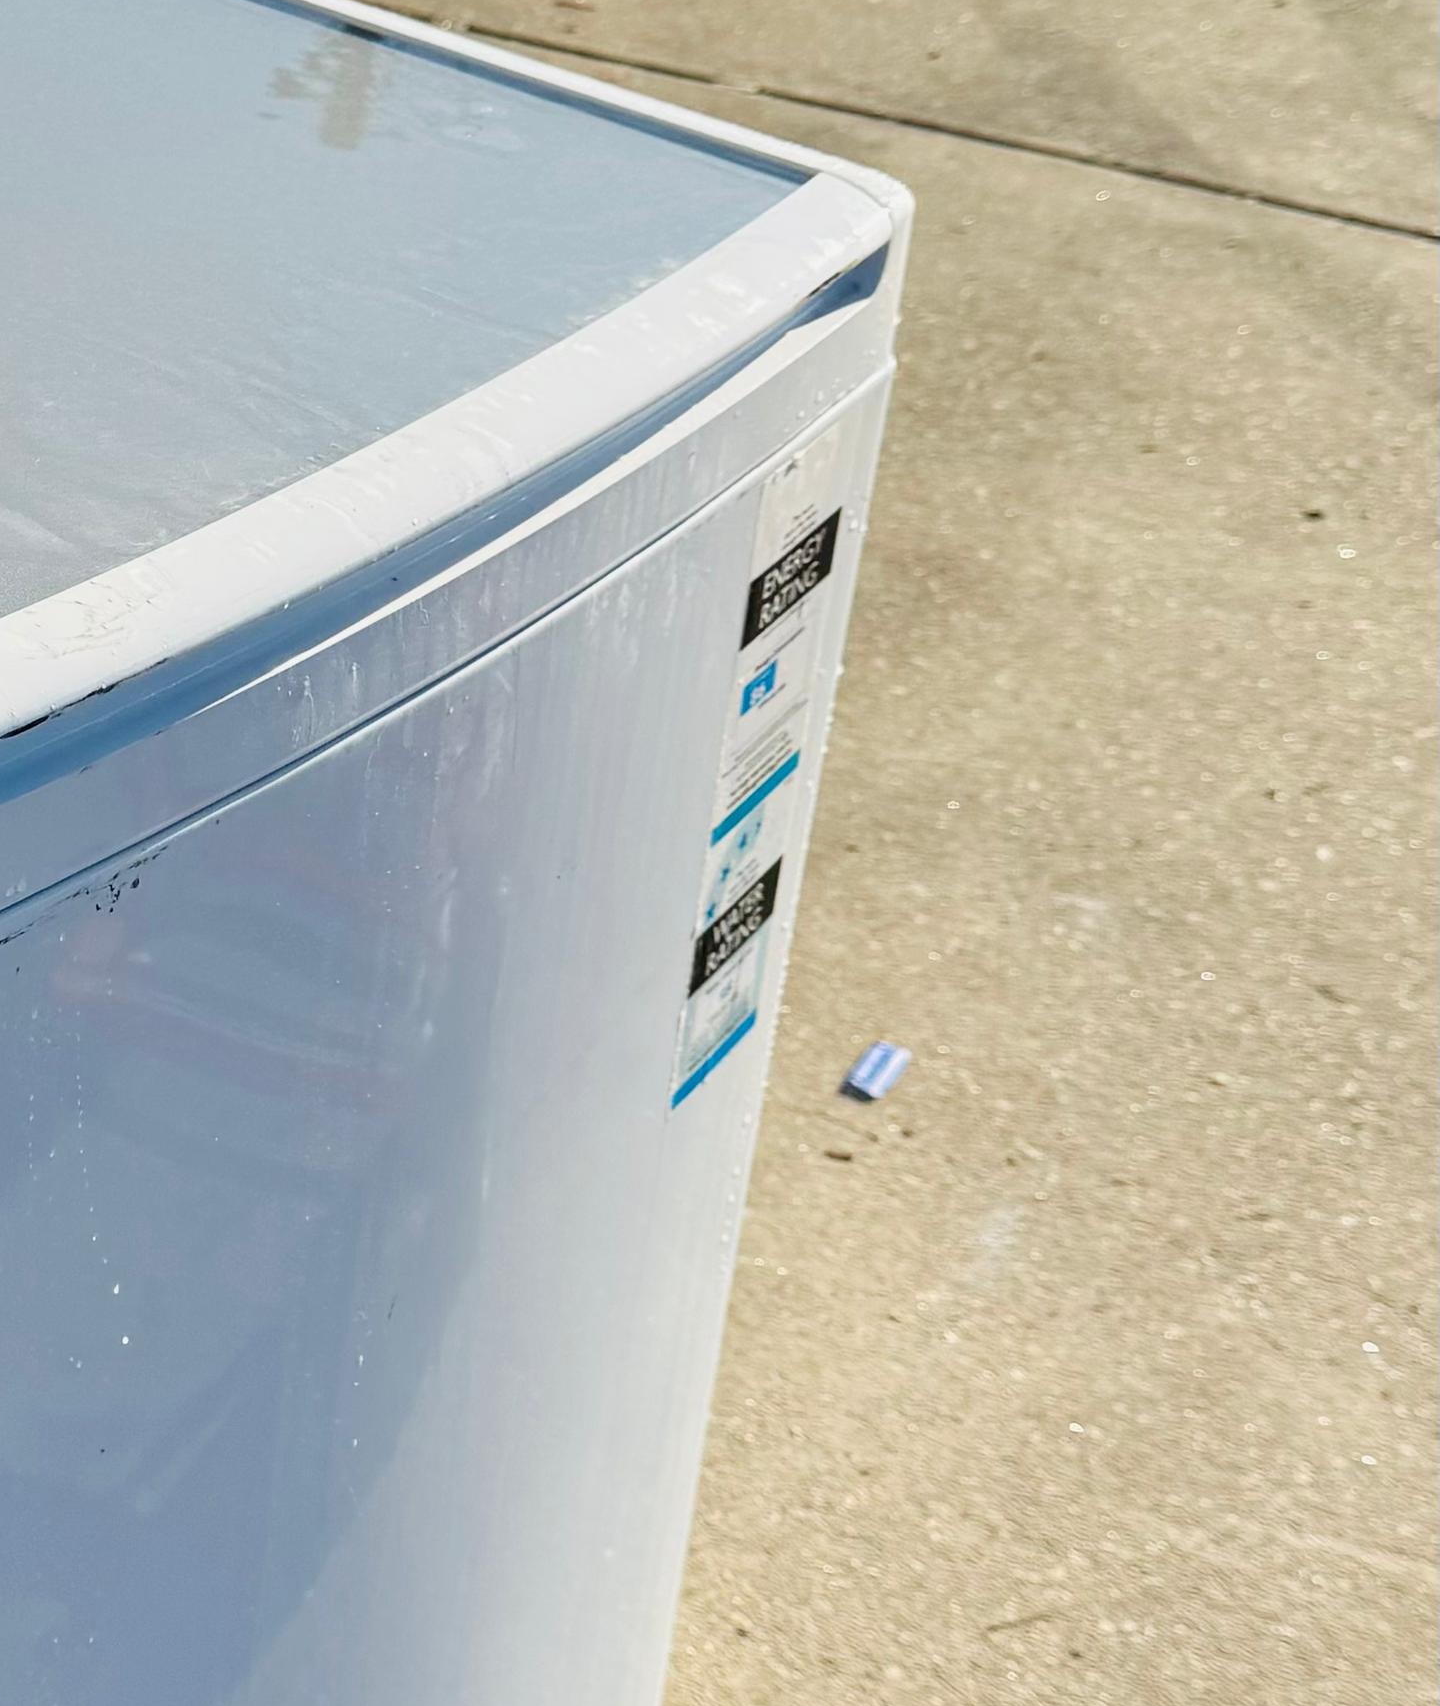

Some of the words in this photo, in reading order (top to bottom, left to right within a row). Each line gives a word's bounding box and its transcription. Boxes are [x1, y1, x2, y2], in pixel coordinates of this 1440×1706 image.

[758, 560, 819, 630] RATING
[760, 527, 826, 600] ENERGY
[705, 905, 764, 977] RATING
